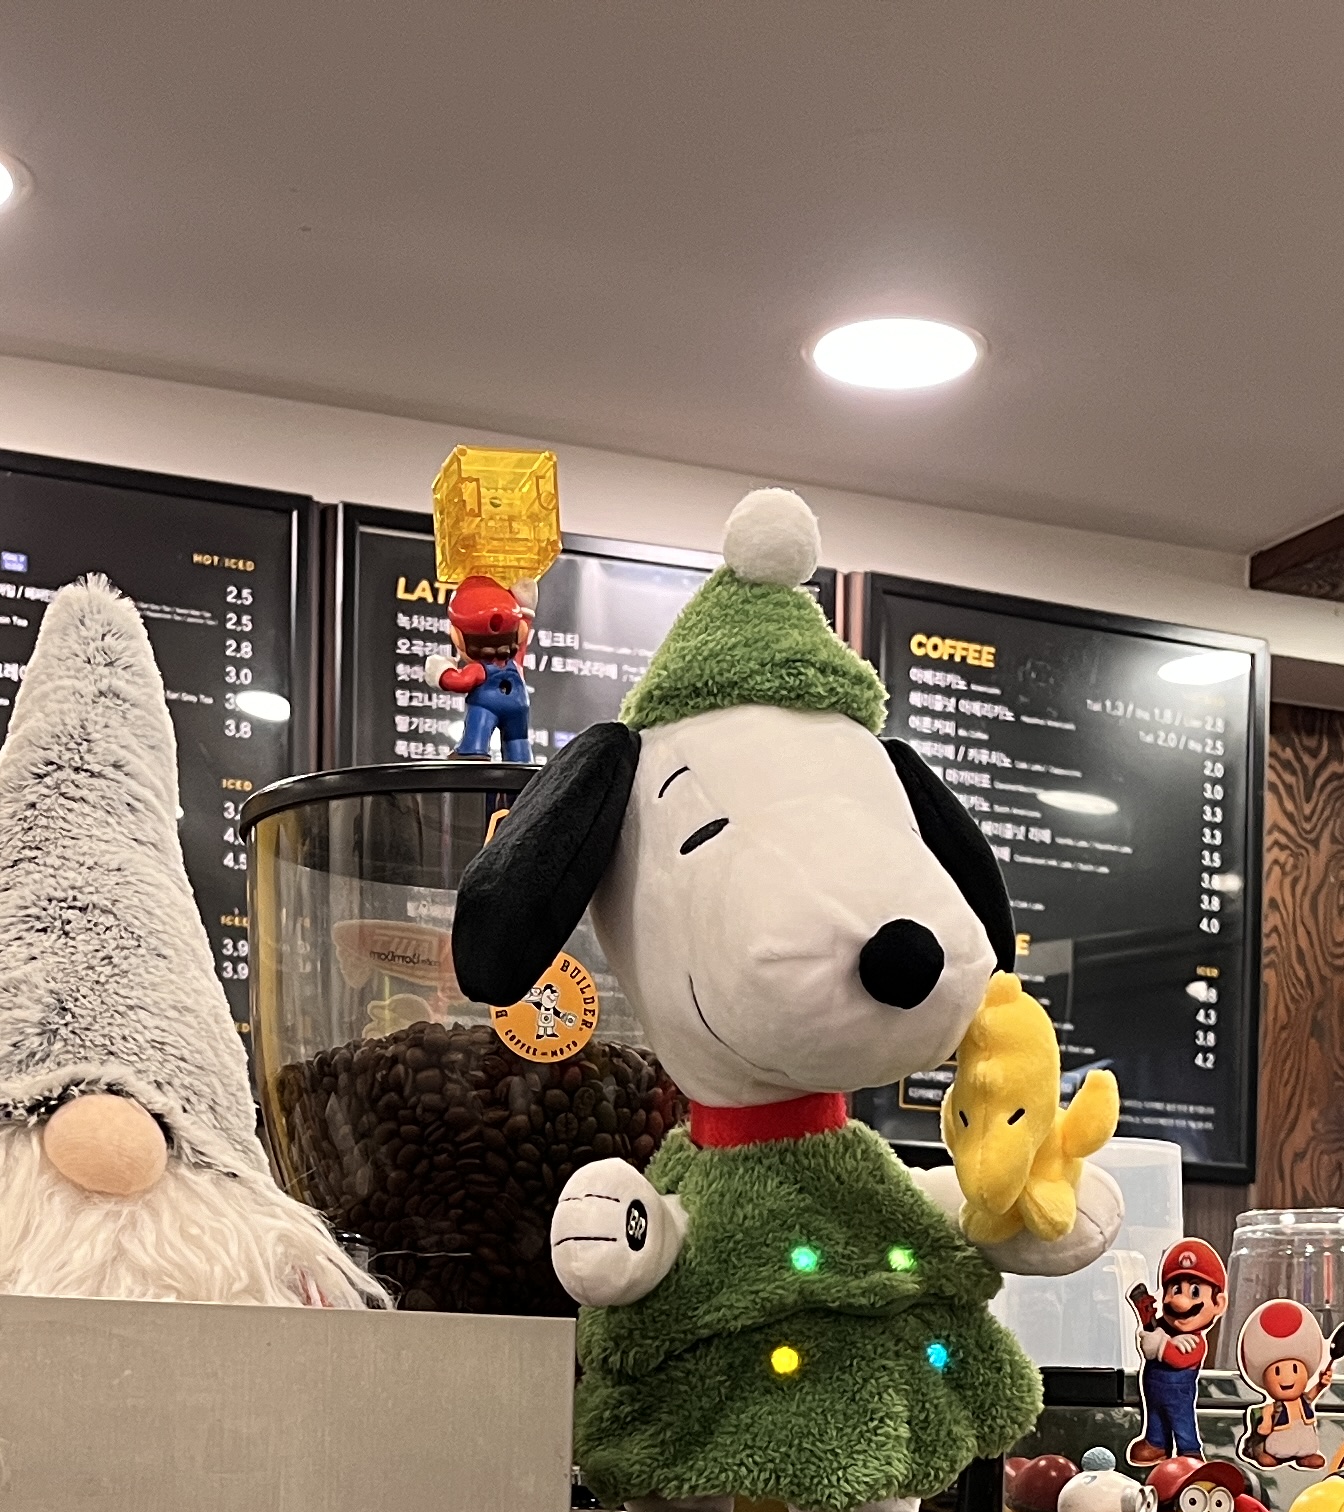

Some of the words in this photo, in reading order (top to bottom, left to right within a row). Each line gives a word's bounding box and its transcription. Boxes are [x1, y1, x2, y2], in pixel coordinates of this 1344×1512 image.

[226, 586, 253, 605] 2.5
[396, 577, 458, 604] LAT
[226, 612, 253, 632] 2.5
[225, 639, 253, 659] 2.8
[910, 633, 996, 668] COFFEE
[225, 666, 252, 685] 3.0
[224, 719, 252, 739] 3.8
[222, 778, 253, 791] ICED
[560, 959, 596, 1029] BUILDER
